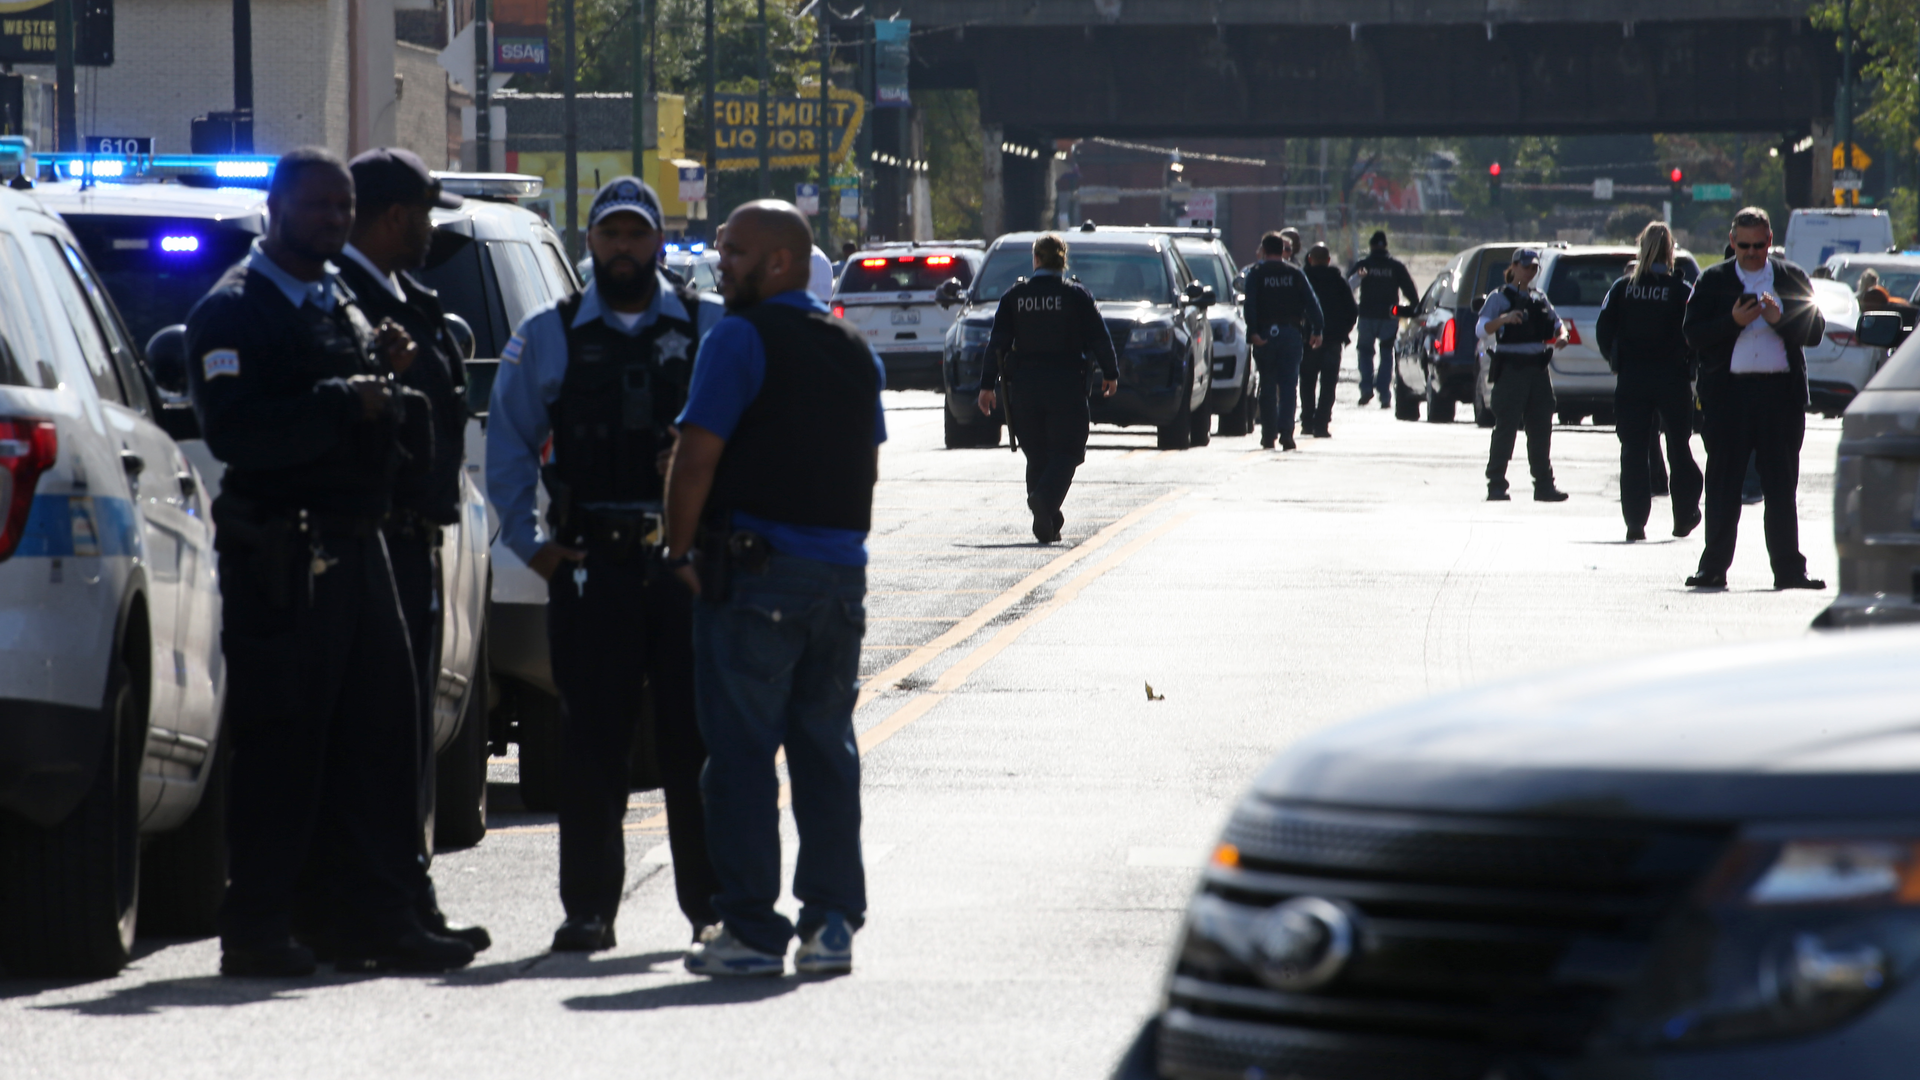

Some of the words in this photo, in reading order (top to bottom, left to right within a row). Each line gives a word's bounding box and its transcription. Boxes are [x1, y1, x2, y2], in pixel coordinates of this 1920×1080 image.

[3, 19, 57, 35] WESTER
[22, 35, 57, 51] UNIO
[100, 138, 139, 155] 610
[1264, 276, 1293, 287] POLICE
[1625, 284, 1670, 301] POLICE
[1017, 295, 1062, 312] POLICE
